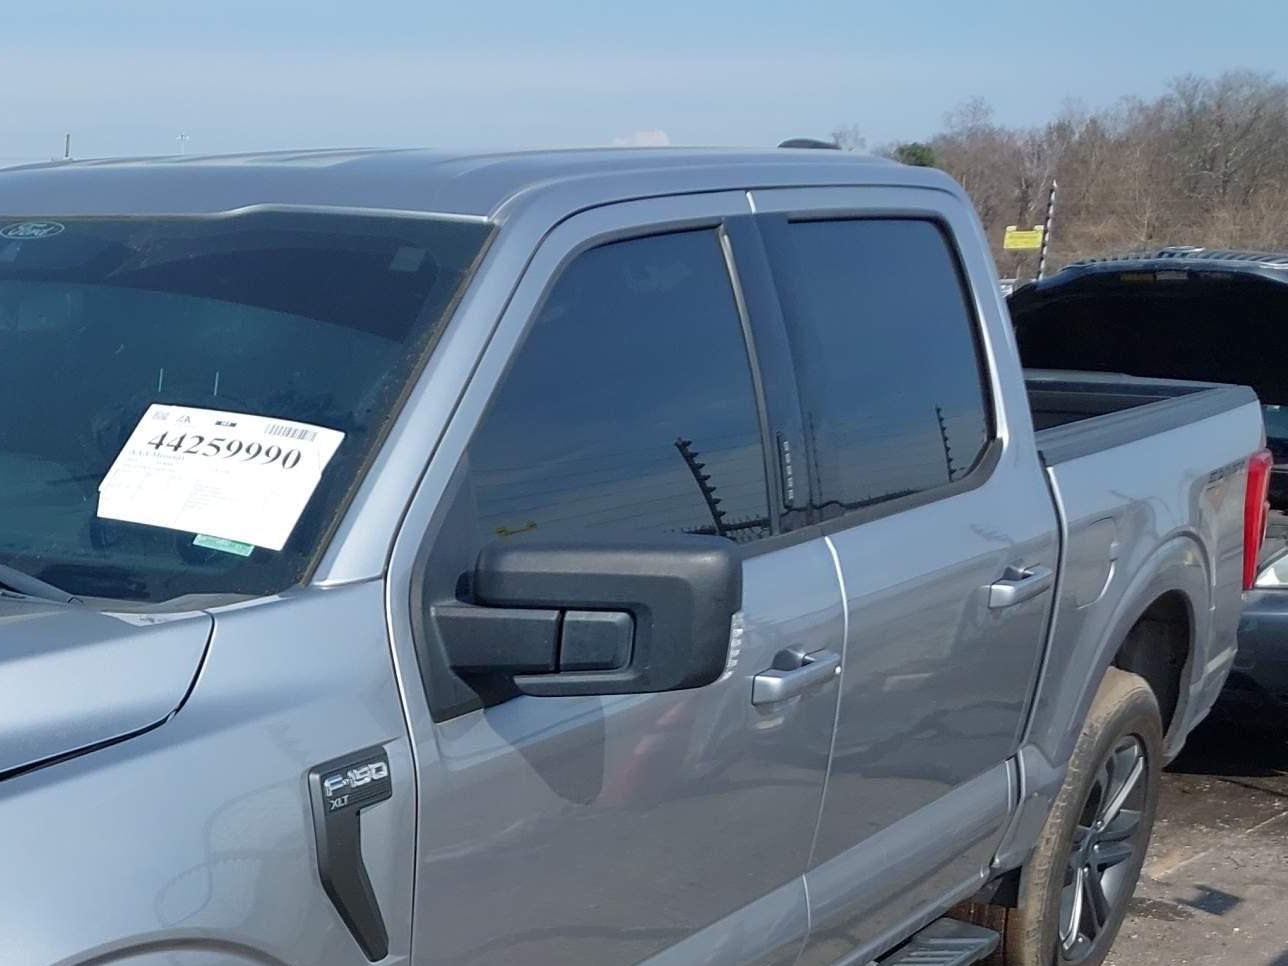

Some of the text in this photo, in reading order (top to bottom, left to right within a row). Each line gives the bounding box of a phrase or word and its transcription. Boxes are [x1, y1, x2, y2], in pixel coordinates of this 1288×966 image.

[147, 431, 302, 470] 44259990
[324, 761, 389, 796] F-150
[330, 795, 350, 810] XLT
